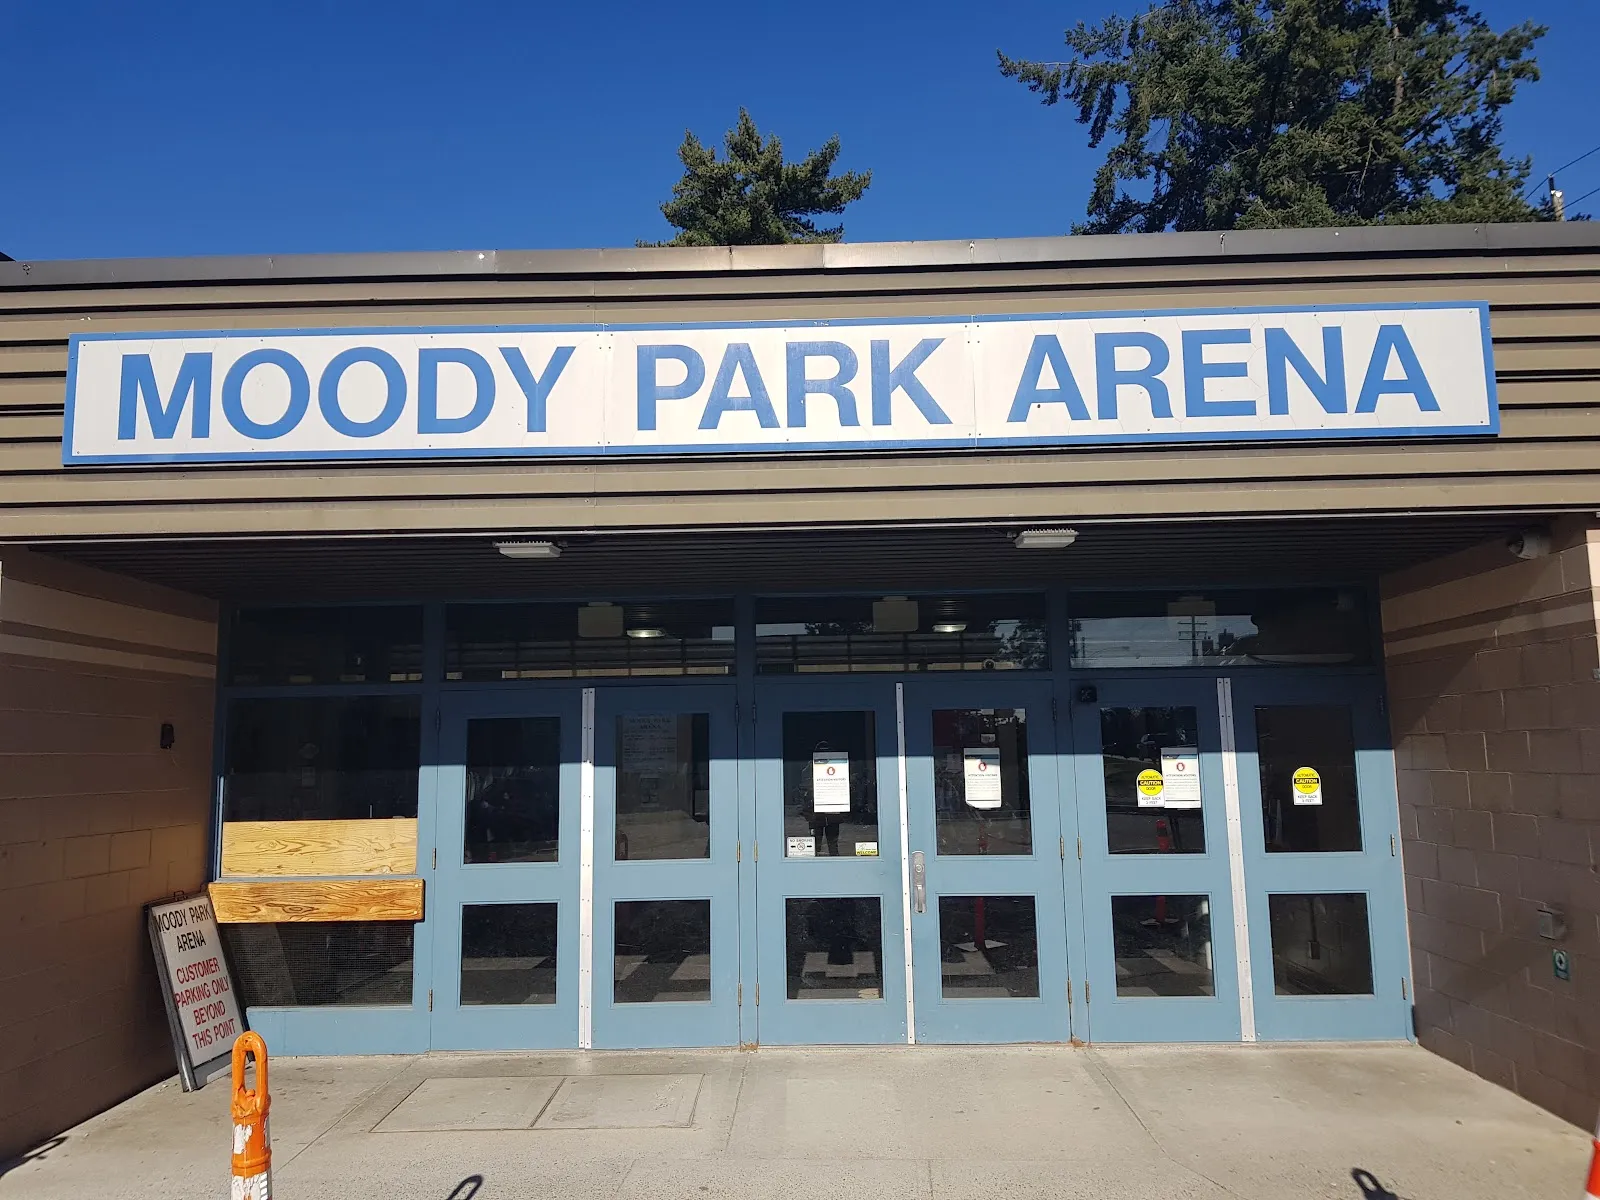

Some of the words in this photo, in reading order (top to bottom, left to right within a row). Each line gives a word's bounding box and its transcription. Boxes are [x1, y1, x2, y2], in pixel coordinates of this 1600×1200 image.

[118, 347, 575, 440] MOODY
[636, 338, 953, 431] PARK
[1007, 324, 1441, 422] ARENA
[155, 909, 188, 932] MOODY
[189, 904, 212, 924] PARK
[176, 930, 206, 952] ARENA
[176, 957, 220, 984] CUSTOMER
[174, 982, 210, 1008] PARKING
[212, 976, 230, 996] ONLY
[194, 1000, 226, 1026] BEYOND
[192, 1028, 212, 1050] THIS
[214, 1018, 236, 1042] POINT
